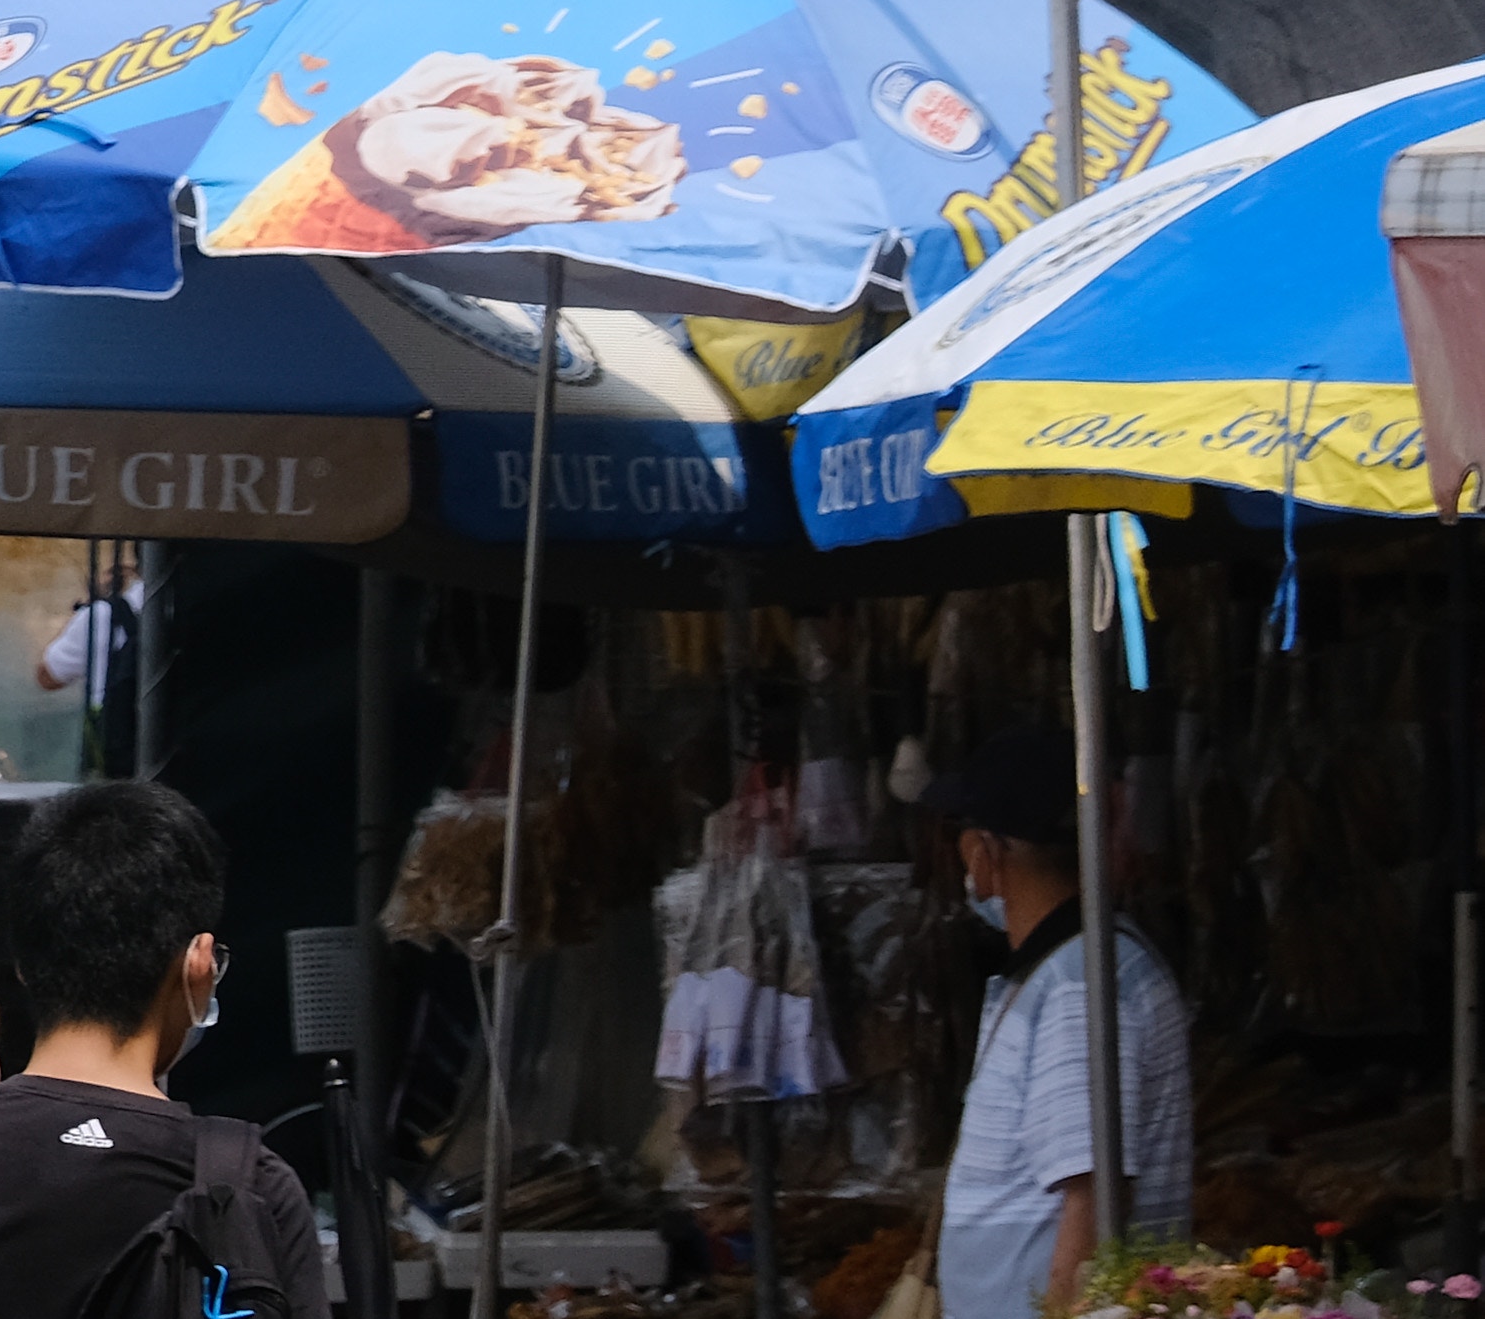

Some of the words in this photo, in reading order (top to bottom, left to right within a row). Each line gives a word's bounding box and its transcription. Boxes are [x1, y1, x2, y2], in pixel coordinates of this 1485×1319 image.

[1026, 411, 1187, 451] Blue
[1200, 405, 1353, 462] Girl
[120, 450, 316, 518] GIRL
[496, 448, 619, 513] BUE
